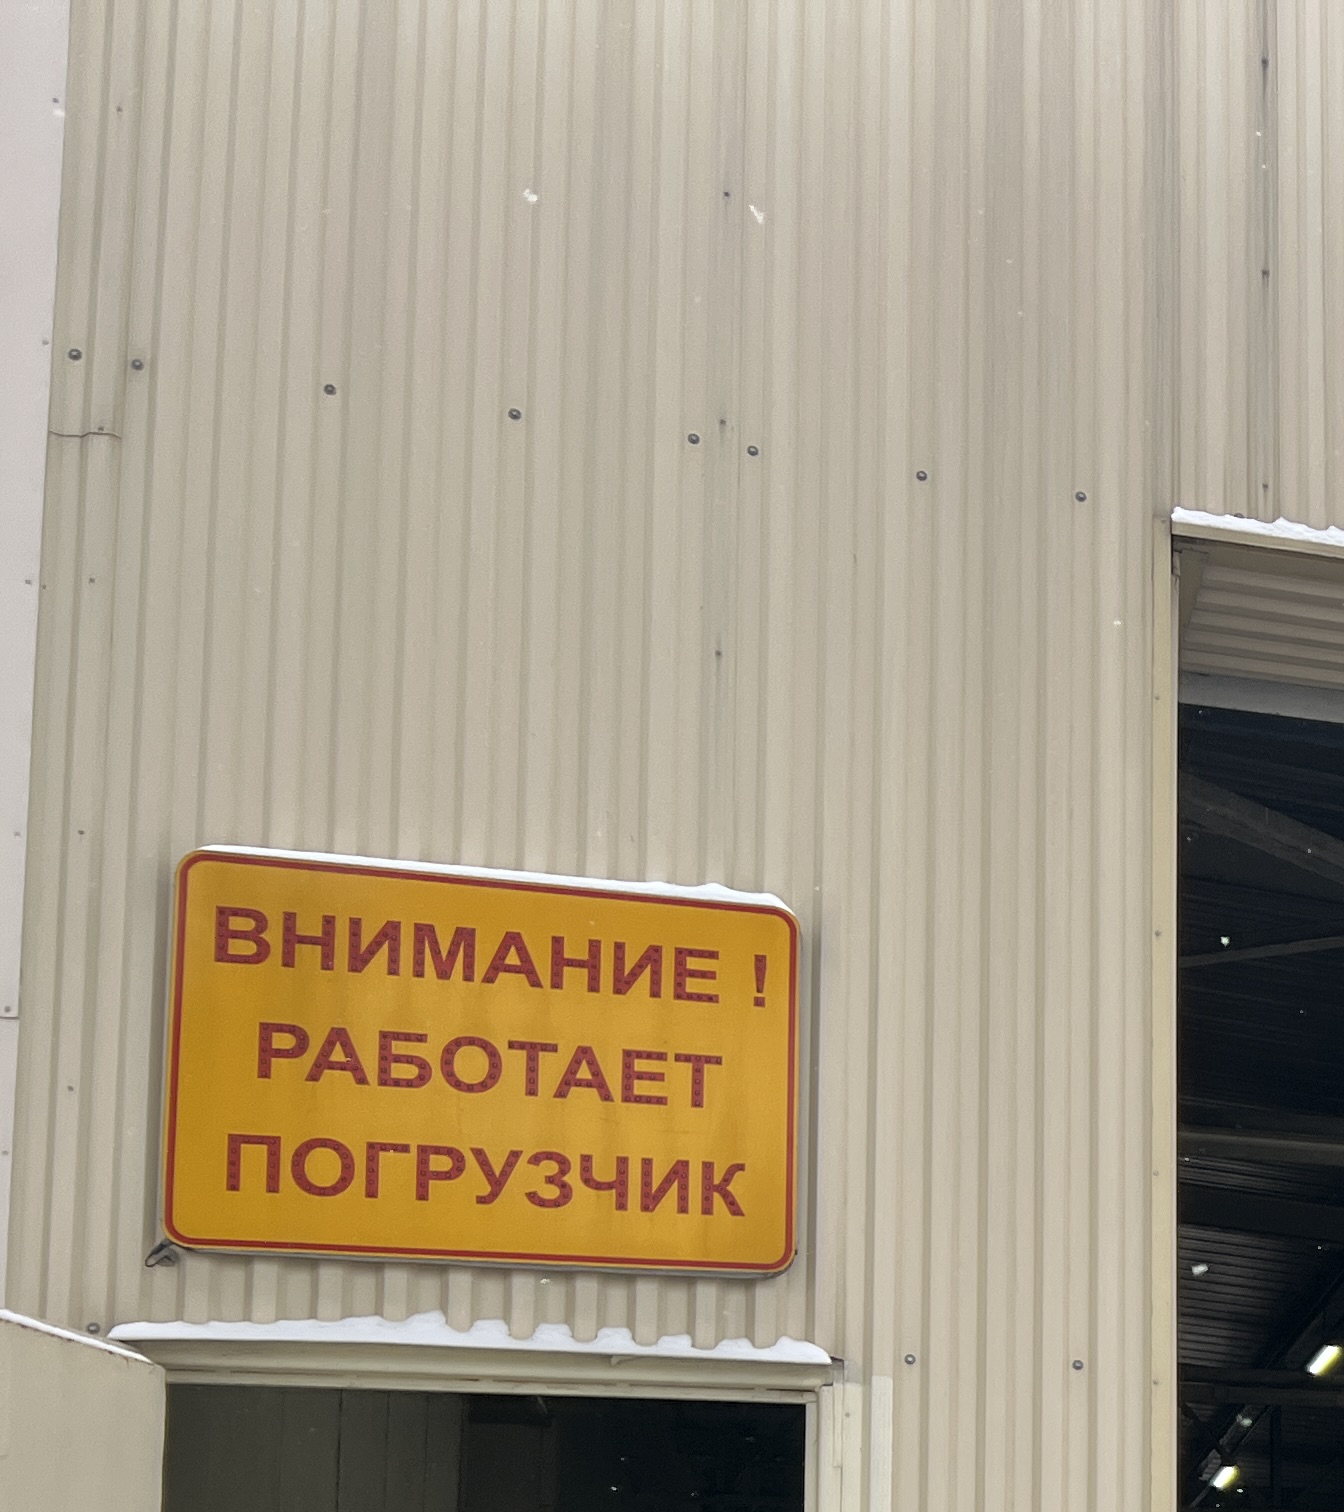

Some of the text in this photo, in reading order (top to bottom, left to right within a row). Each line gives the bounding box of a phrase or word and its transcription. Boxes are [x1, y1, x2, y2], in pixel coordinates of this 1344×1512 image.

[213, 905, 720, 1004] ВНИМАНИЕ
[257, 1021, 723, 1109] РАБОТАЕТ
[225, 1133, 746, 1218] ПОГРУЗЧИК
